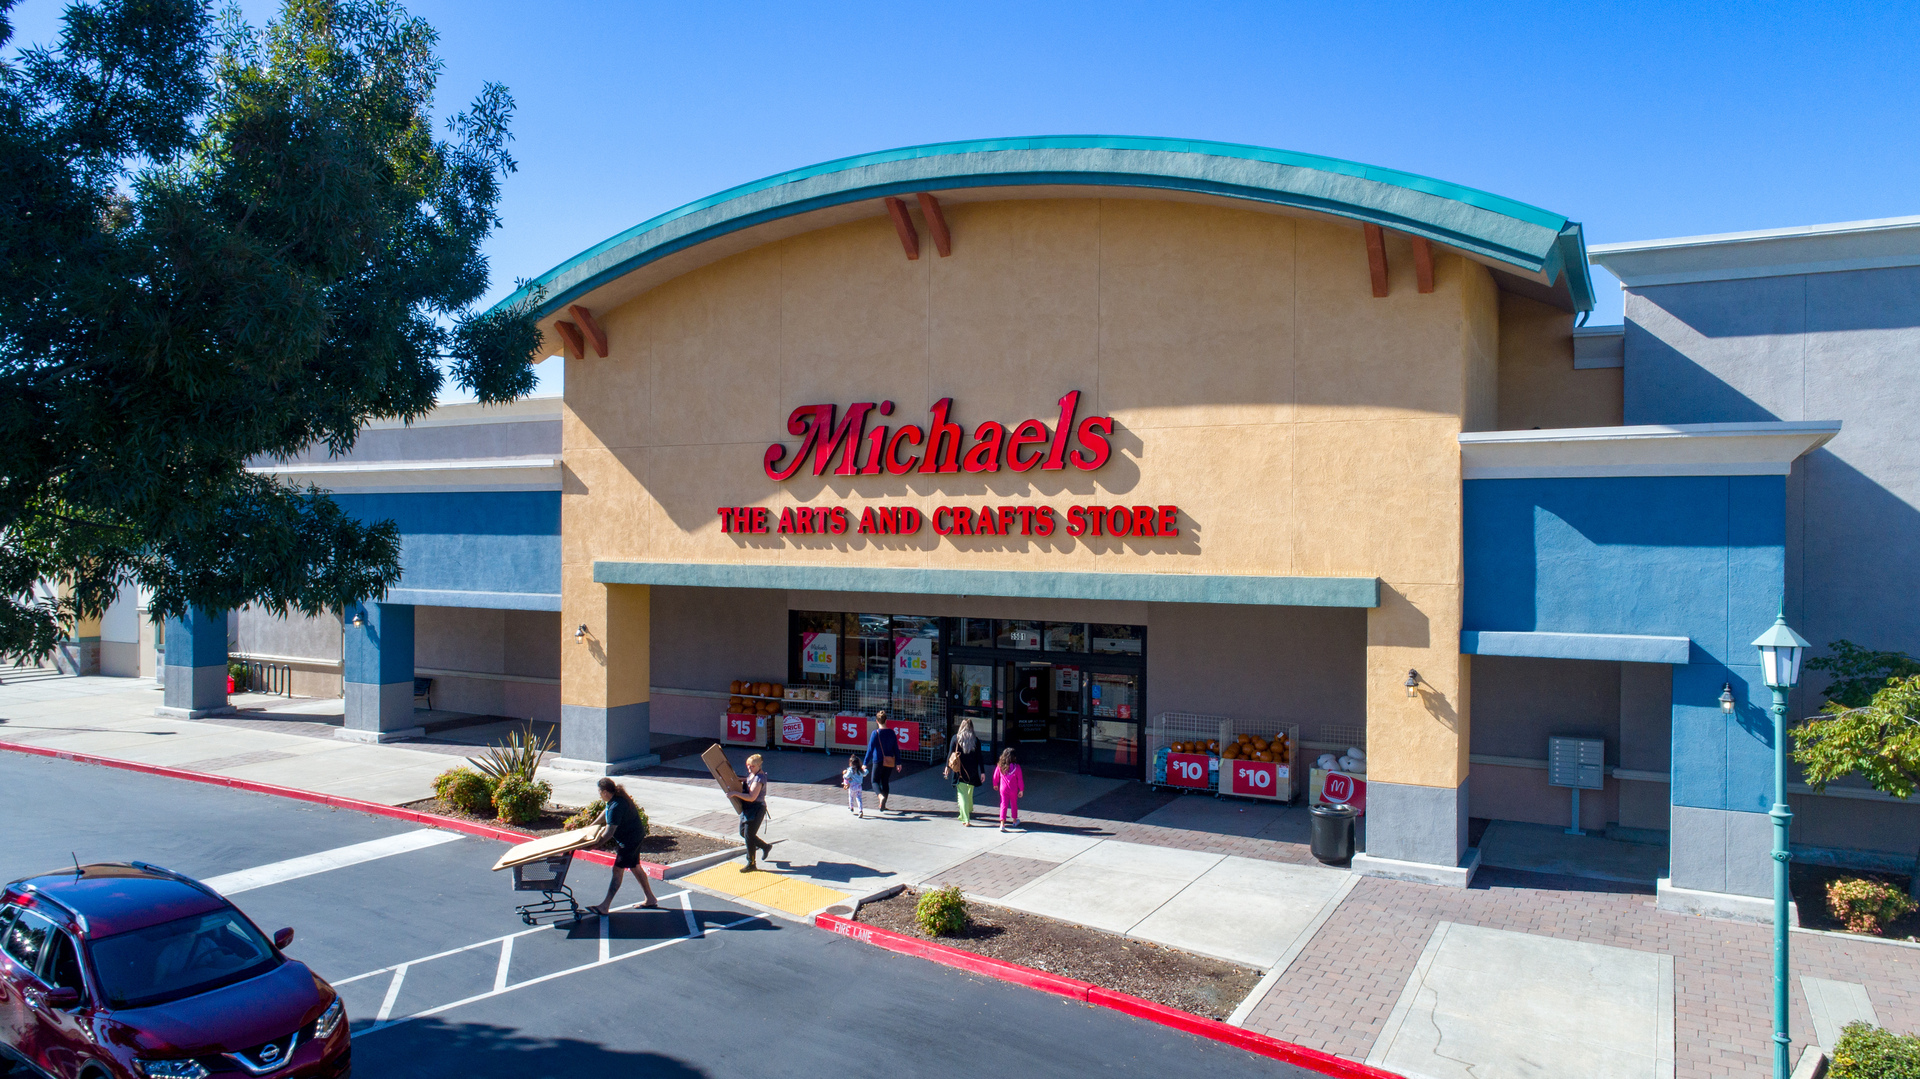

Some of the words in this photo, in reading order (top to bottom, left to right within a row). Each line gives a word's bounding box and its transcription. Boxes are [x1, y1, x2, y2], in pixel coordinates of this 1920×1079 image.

[764, 390, 1114, 481] Michaels
[717, 507, 767, 535] THE
[777, 507, 847, 536] ARTS
[858, 506, 922, 536] AND
[932, 505, 1055, 537] CRAFTS
[1066, 505, 1179, 538] STORE
[807, 650, 832, 663] kids
[900, 656, 927, 669] kids
[731, 720, 751, 735] $15
[842, 722, 858, 738] $5
[893, 727, 910, 743] $5
[1172, 760, 1203, 780] $10
[1239, 768, 1270, 788] $10
[834, 922, 851, 936] FIRE
[853, 927, 873, 943] LANE
